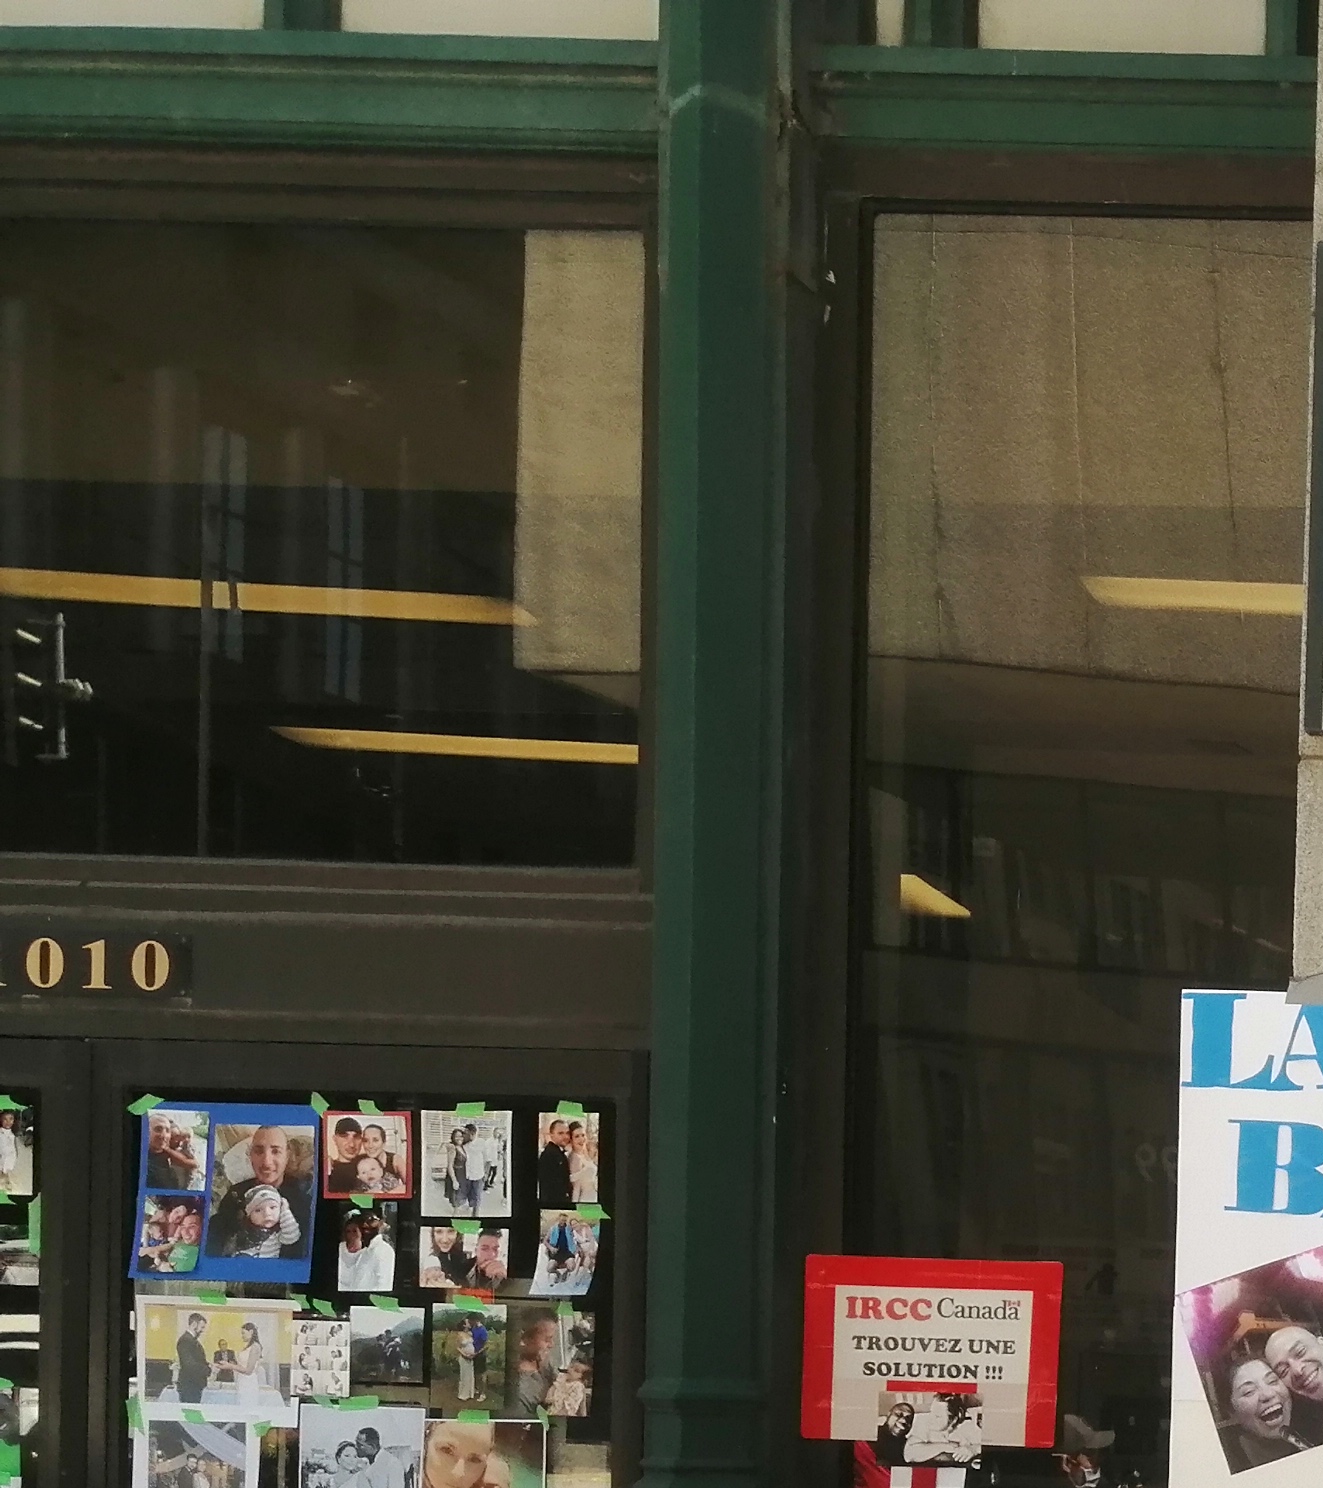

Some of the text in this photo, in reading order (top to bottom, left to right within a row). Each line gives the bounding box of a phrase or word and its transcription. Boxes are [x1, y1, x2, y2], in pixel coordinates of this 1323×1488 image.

[0, 937, 170, 991] 010
[845, 1296, 1021, 1321] IRCC Canada
[852, 1335, 1016, 1355] TROUVEZ UNE
[862, 1362, 1003, 1380] SOLUTION !!!
